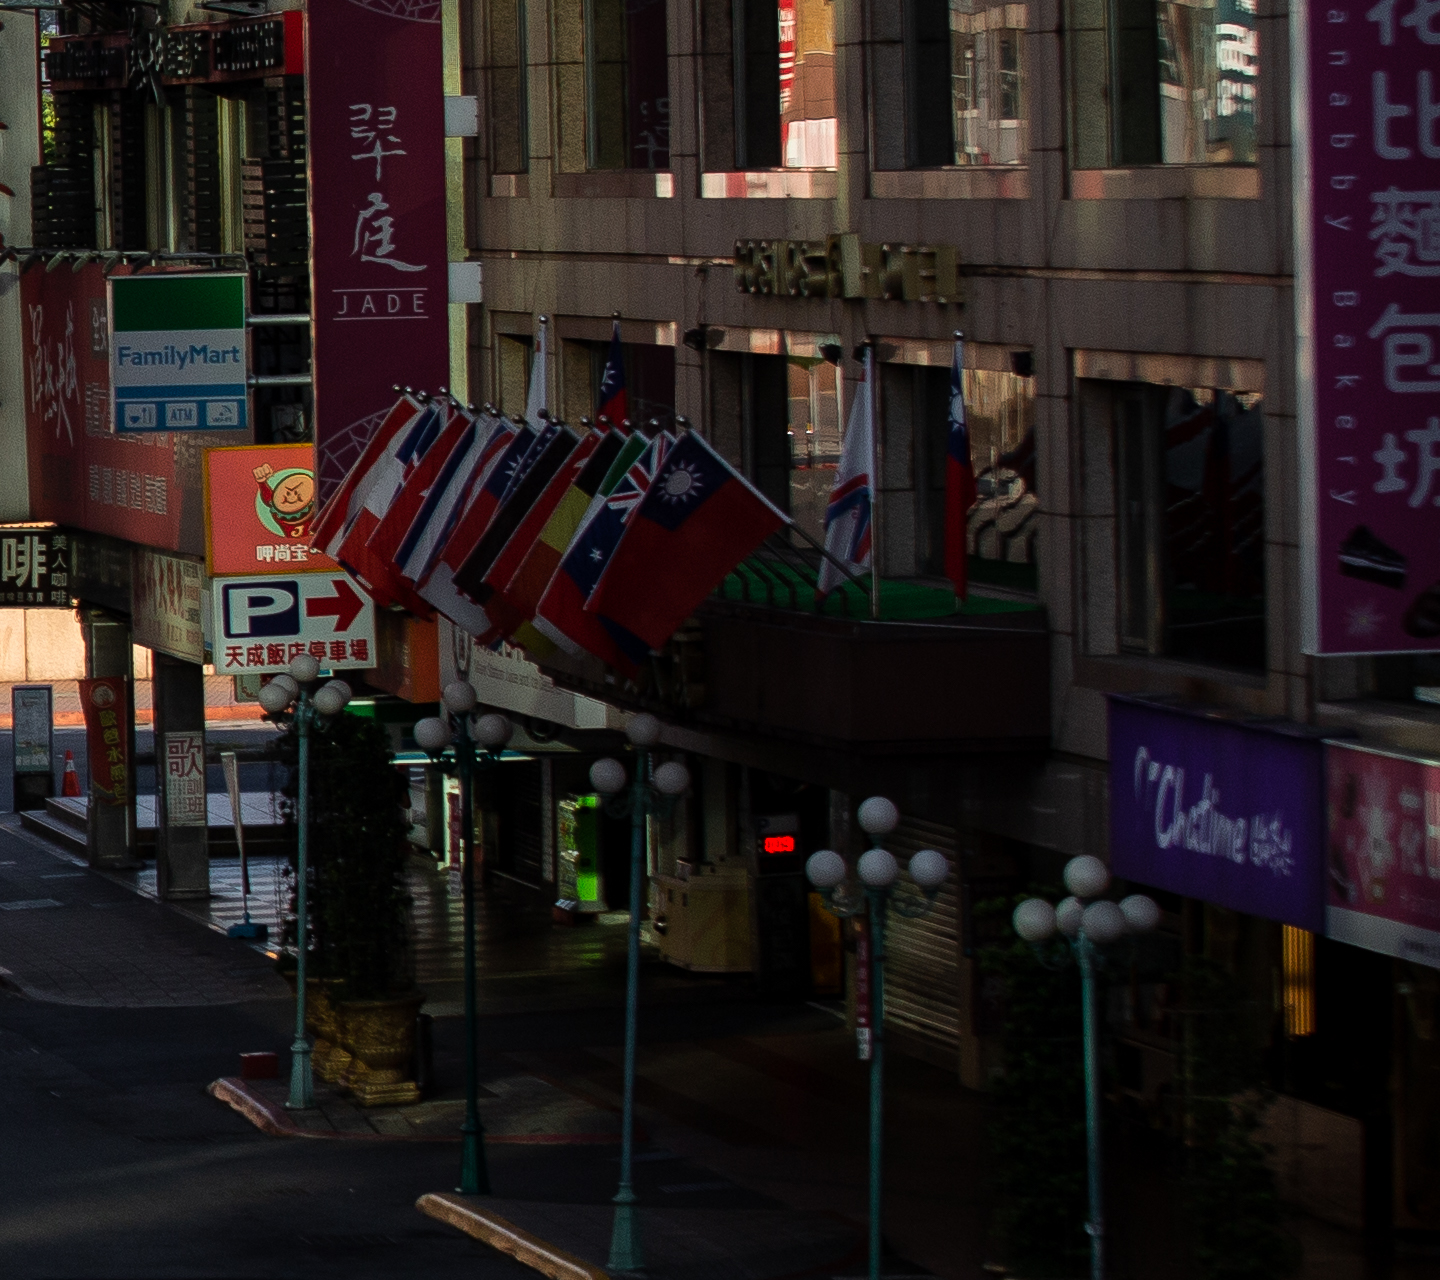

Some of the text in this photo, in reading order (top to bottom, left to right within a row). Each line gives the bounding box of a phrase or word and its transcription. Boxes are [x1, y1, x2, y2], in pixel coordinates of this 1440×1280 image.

[336, 293, 425, 315] JADE
[117, 344, 240, 370] FamilyMart
[169, 408, 194, 421] ATM
[1329, 289, 1363, 506] Bakery
[50, 534, 68, 606] 美人咖啡
[228, 586, 296, 635] P
[224, 638, 369, 669] 天成飯店停車場
[166, 737, 203, 778] 歌
